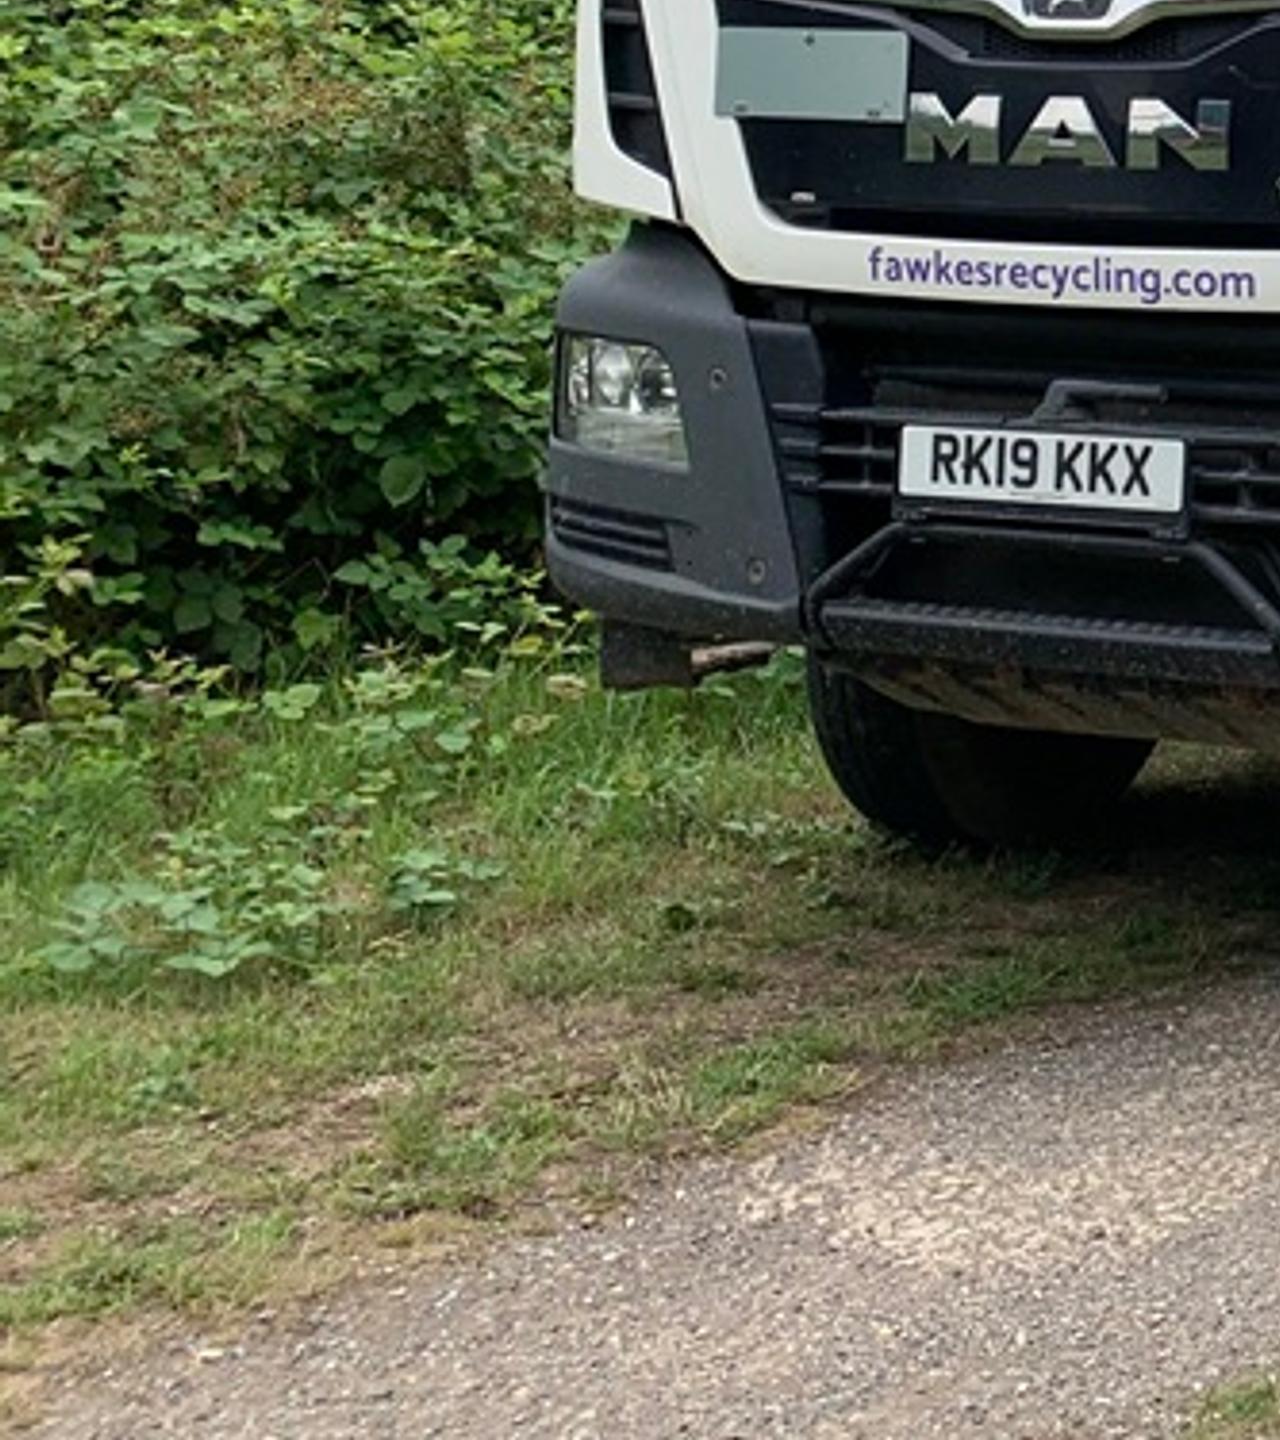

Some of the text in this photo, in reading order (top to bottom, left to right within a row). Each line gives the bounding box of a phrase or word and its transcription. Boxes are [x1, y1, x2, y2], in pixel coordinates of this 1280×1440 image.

[904, 91, 1231, 172] MAN
[869, 247, 1256, 305] fawkesrecycling.com
[930, 433, 1153, 496] RK19 KKX
